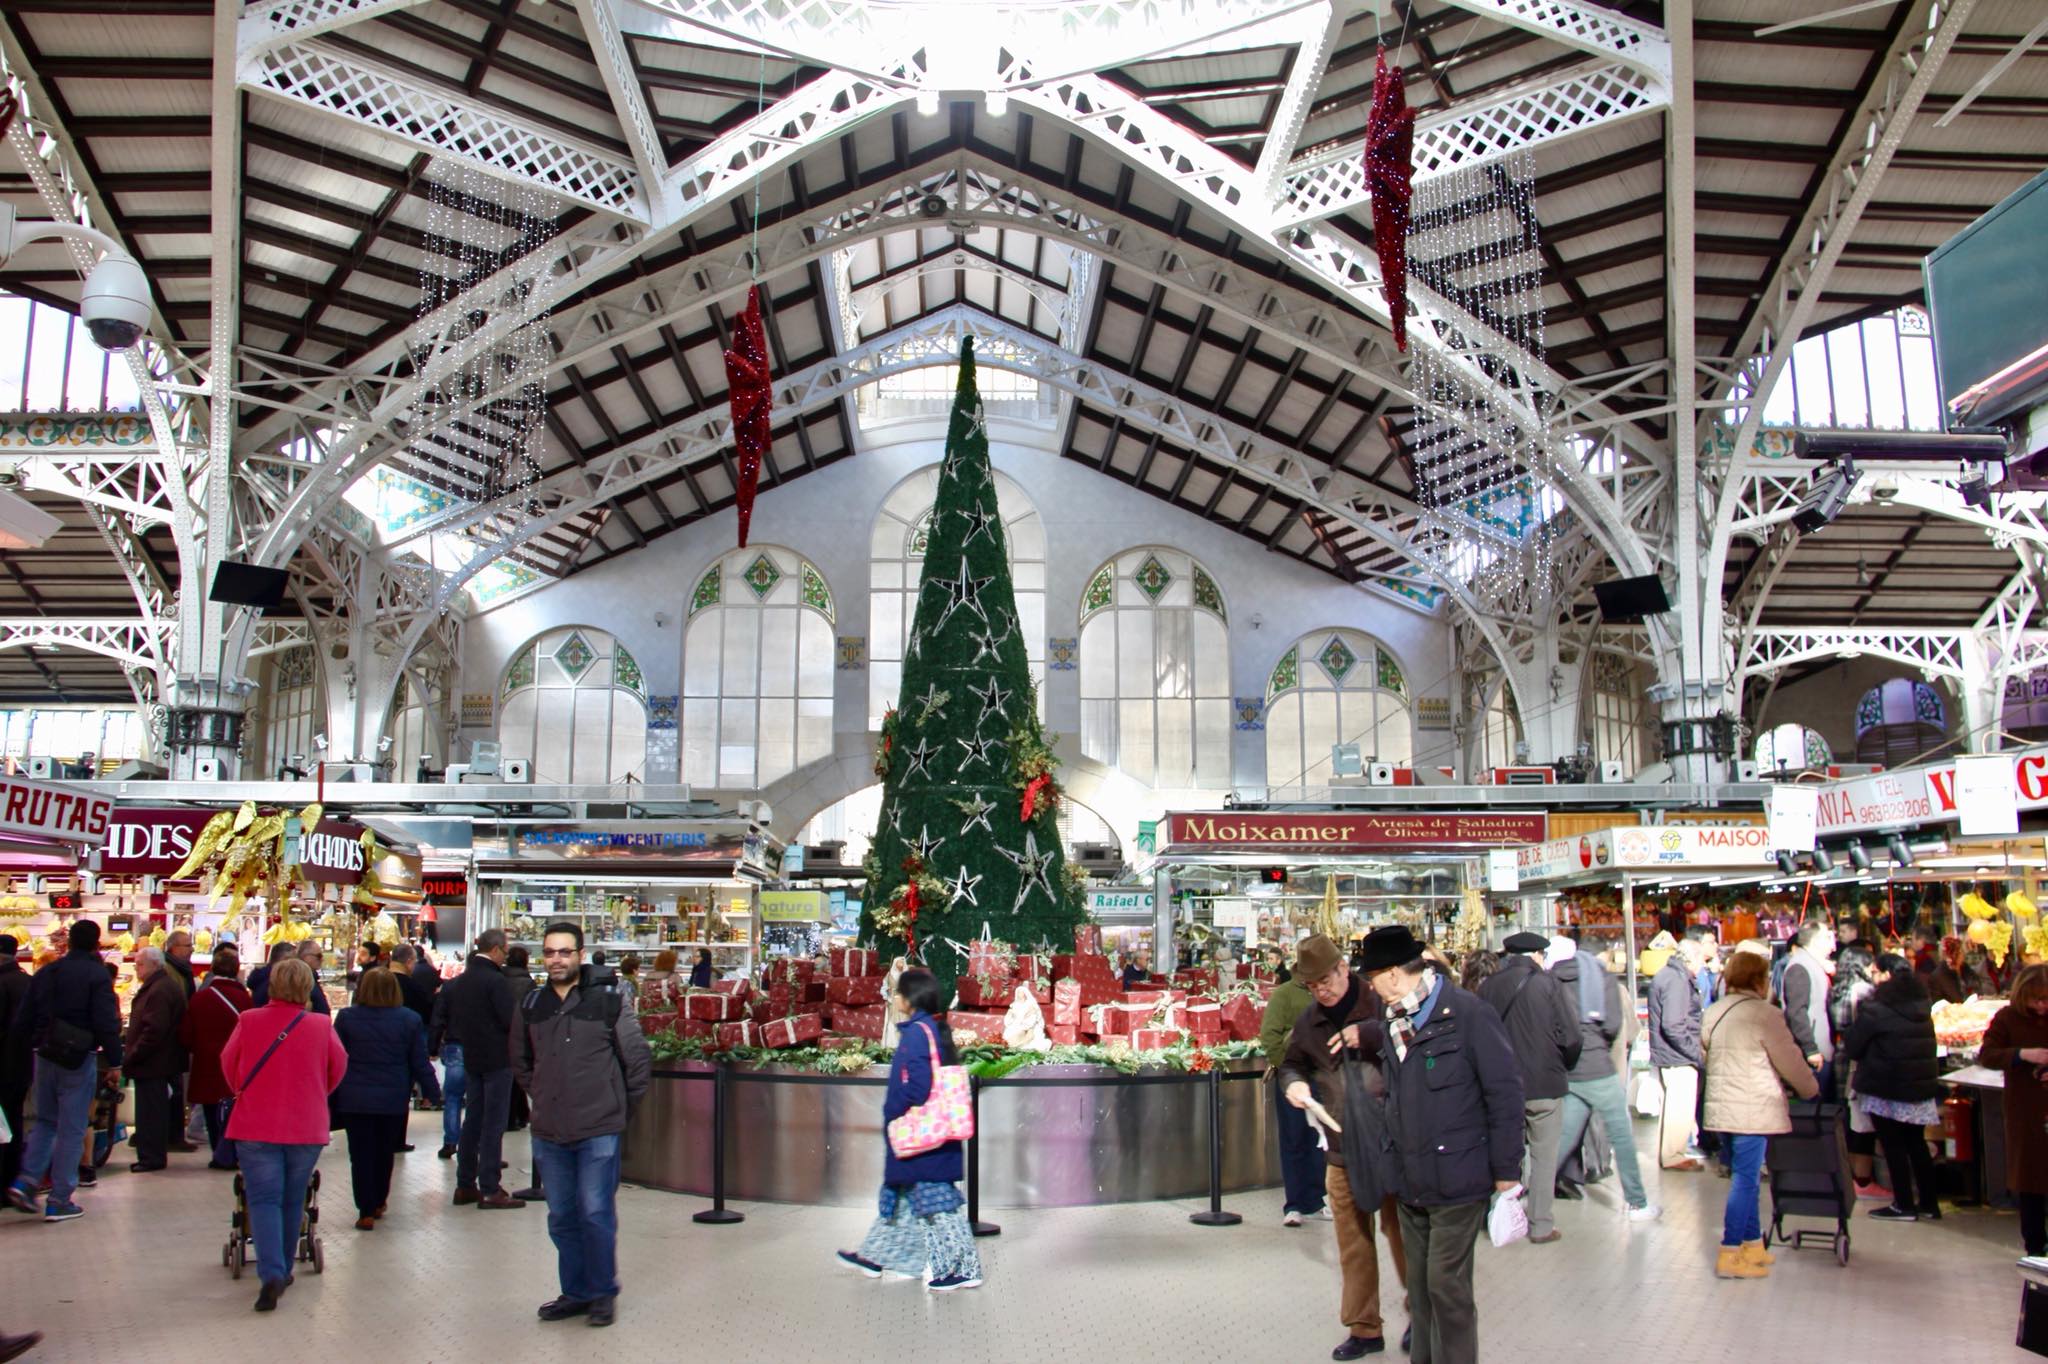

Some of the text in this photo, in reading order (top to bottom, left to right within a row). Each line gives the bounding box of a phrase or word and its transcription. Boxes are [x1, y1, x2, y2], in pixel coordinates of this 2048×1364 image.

[1367, 818, 1534, 828] Artesà de Saladura
[1184, 818, 1355, 841] Moixamer
[1384, 828, 1439, 838] Olives
[1457, 828, 1518, 837] Fumats
[663, 832, 706, 846] PERIS
[56, 896, 71, 908] 25
[1096, 894, 1139, 907] Rafael
